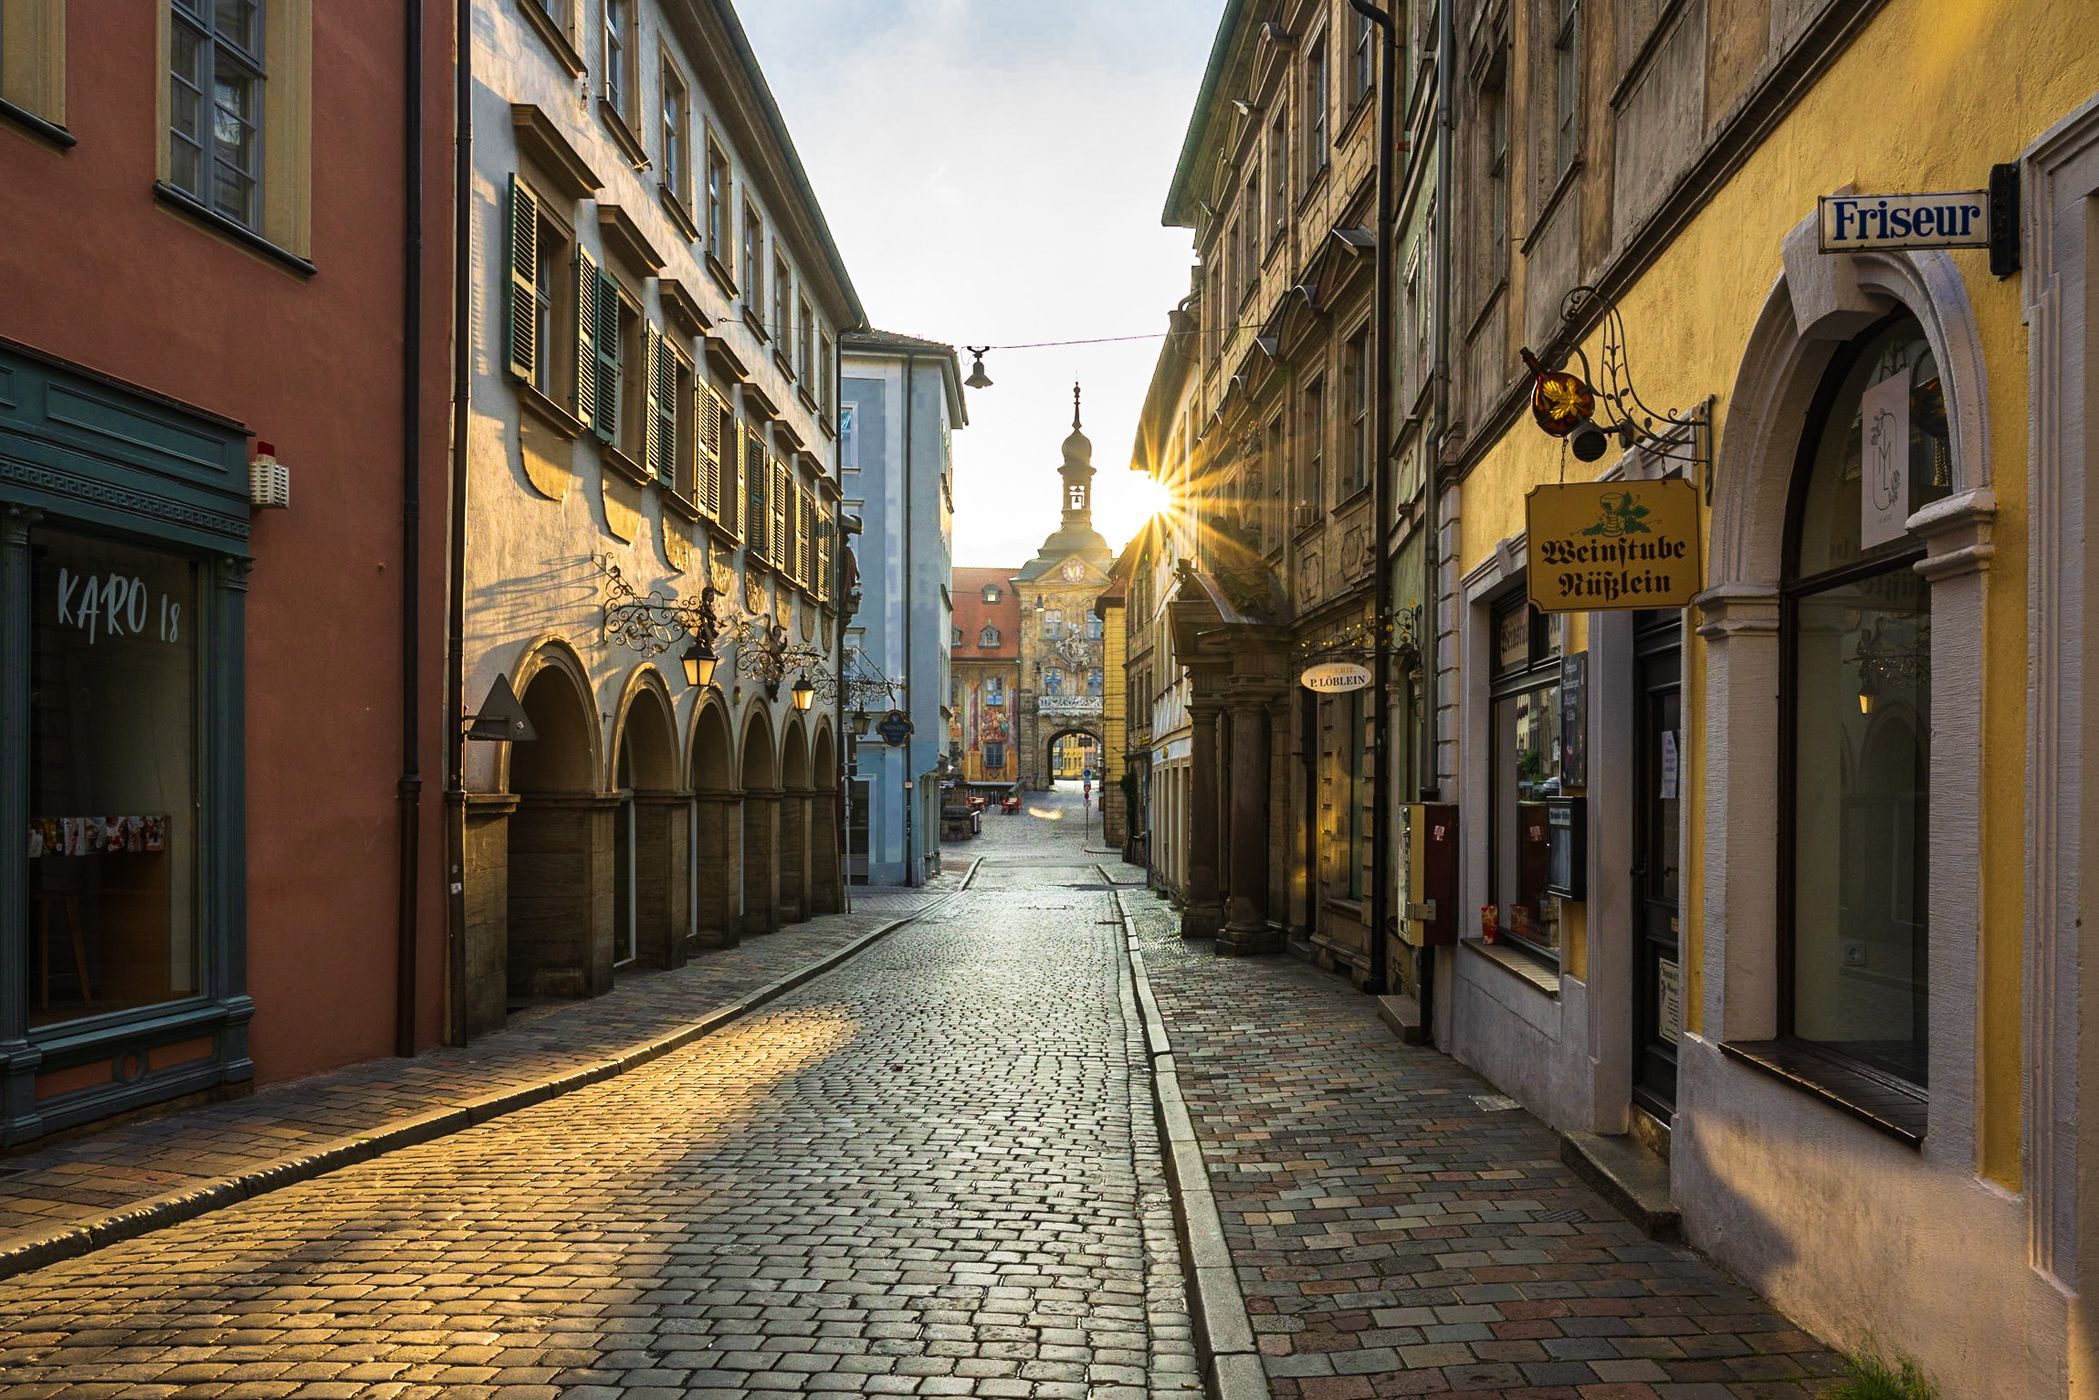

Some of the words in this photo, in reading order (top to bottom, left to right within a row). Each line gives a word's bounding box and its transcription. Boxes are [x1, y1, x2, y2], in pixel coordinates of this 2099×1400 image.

[1833, 200, 1981, 241] Friseur
[1541, 535, 1687, 568] Weinstube
[57, 567, 148, 645] KARO
[160, 593, 181, 644] 18
[1310, 679, 1318, 688] P.
[1319, 674, 1366, 687] LÖBLEIN
